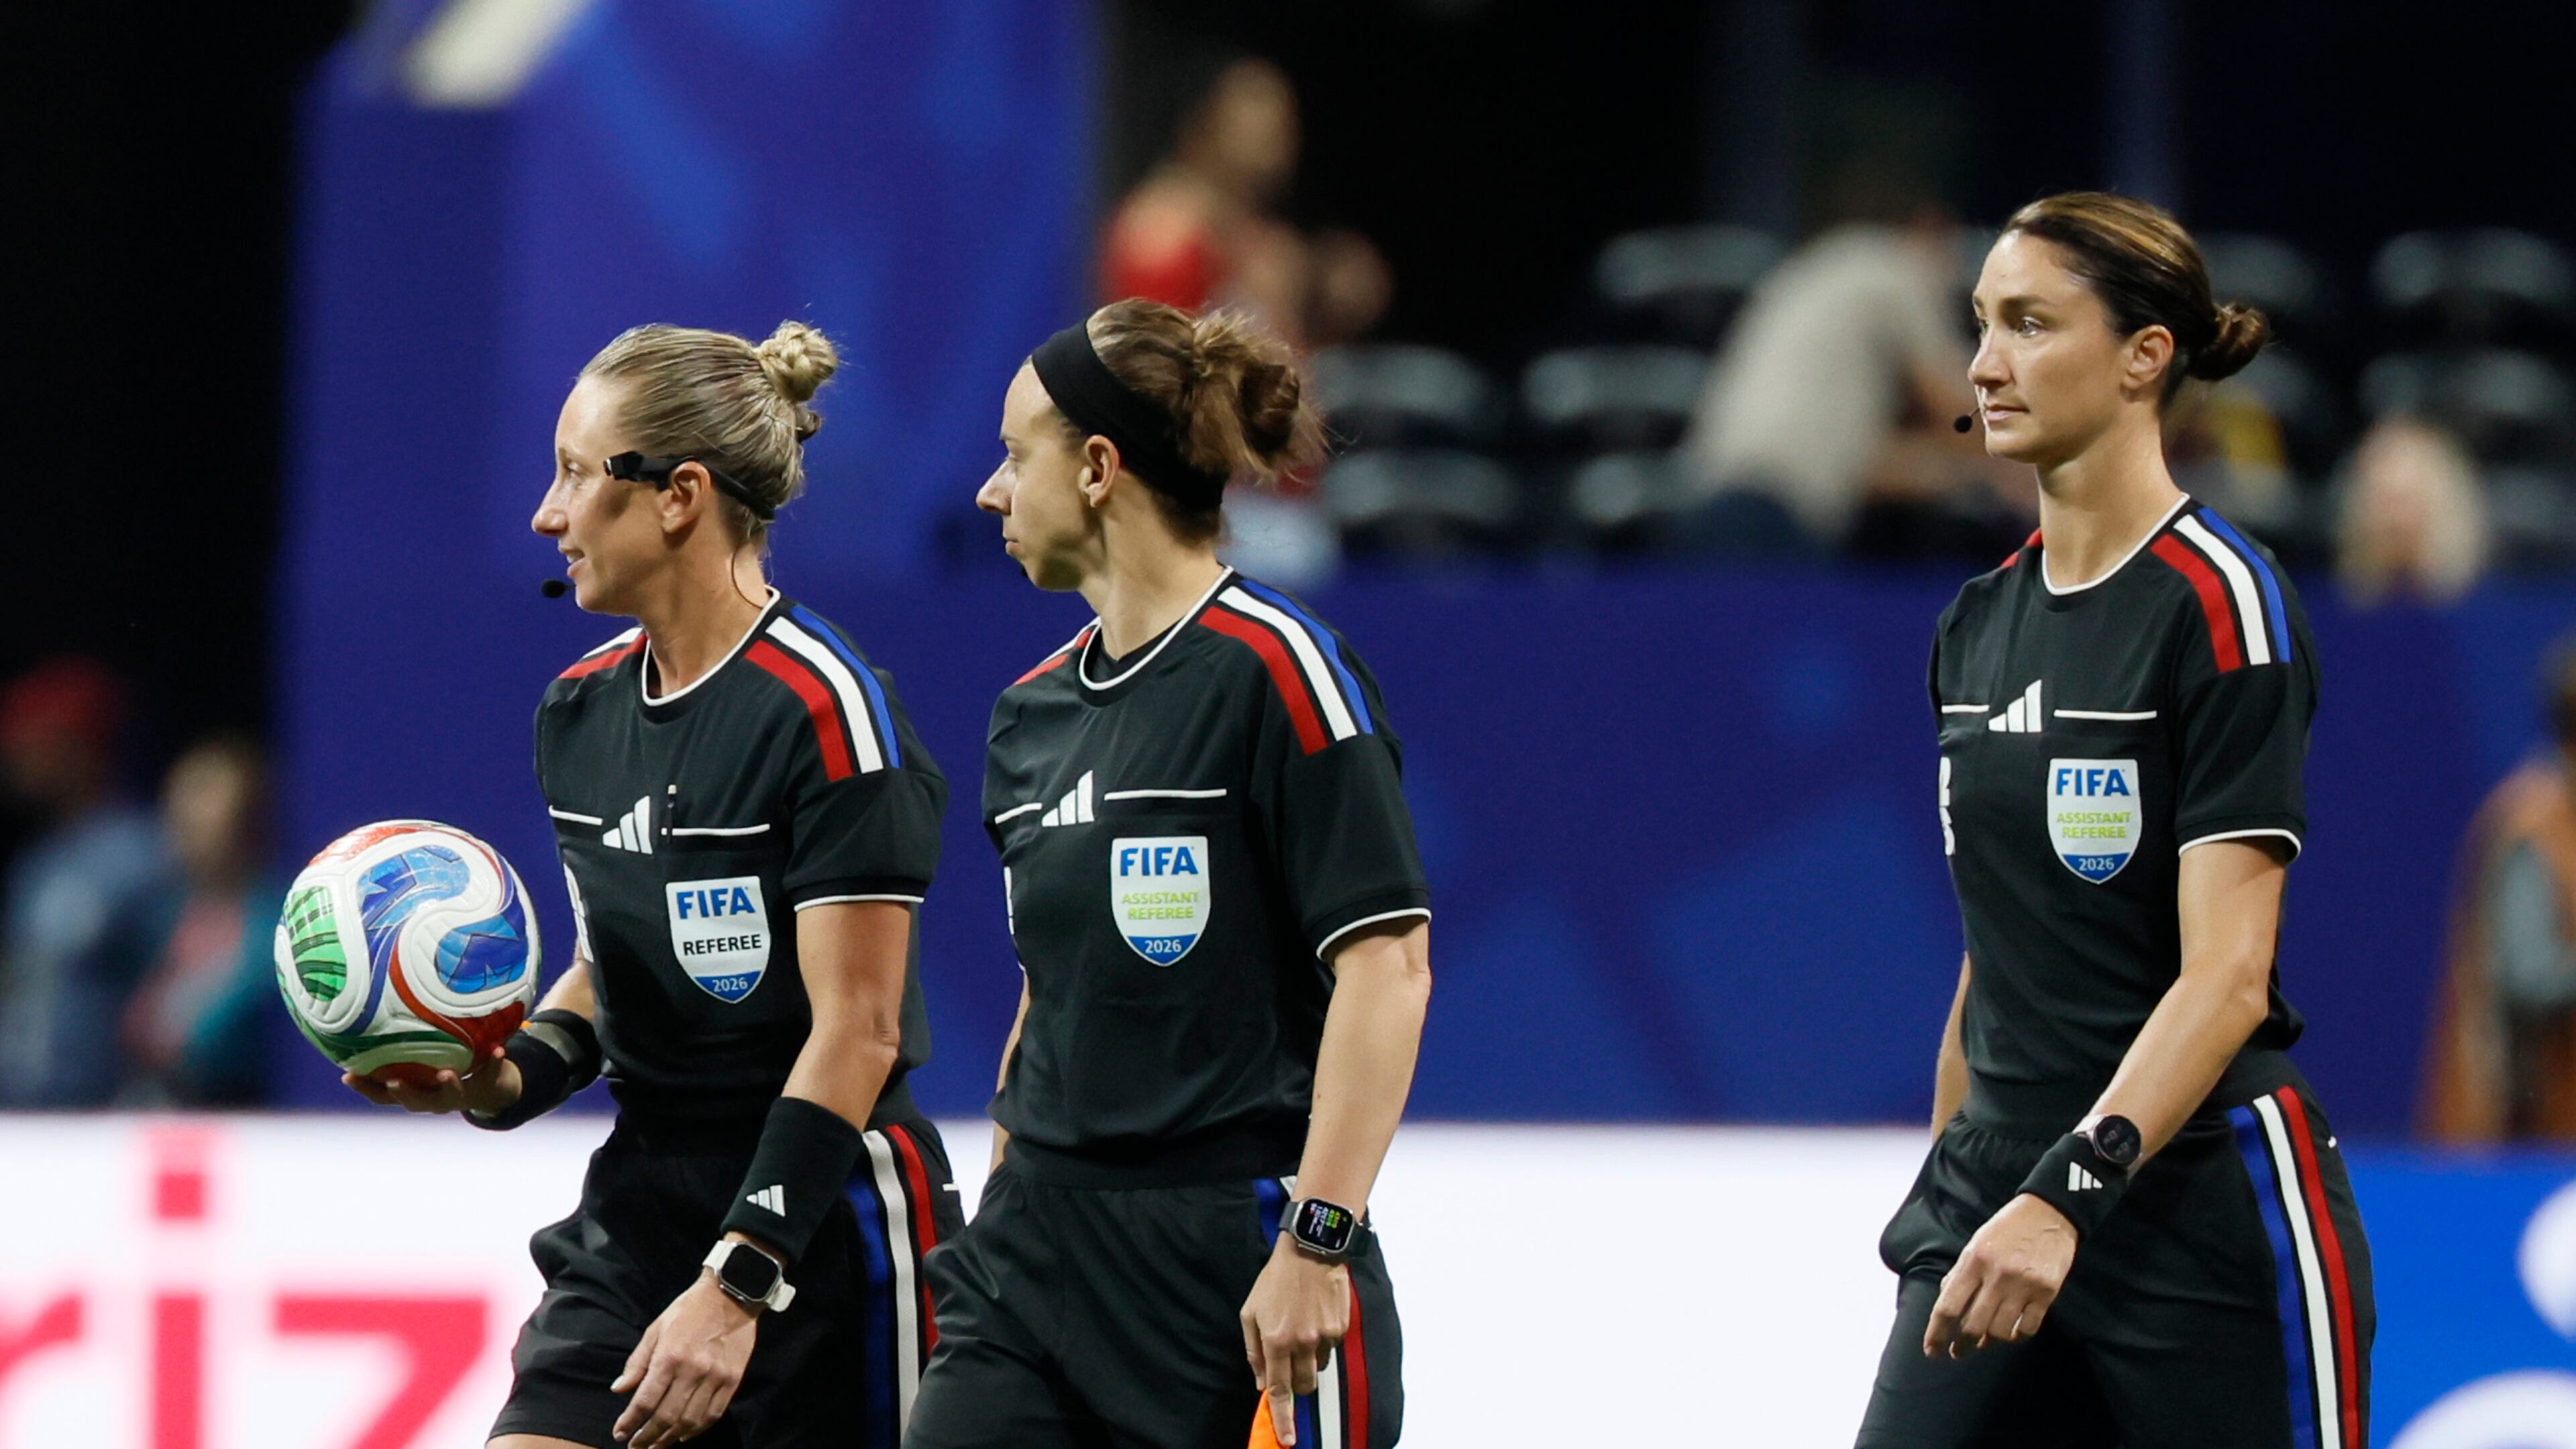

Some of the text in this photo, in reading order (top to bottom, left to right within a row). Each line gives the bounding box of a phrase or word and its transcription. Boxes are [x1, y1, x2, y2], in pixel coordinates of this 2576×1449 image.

[2056, 768, 2131, 797] FIFA
[2057, 811, 2132, 824] ASSISTANT
[2062, 826, 2127, 839] REFEREE
[1120, 846, 1199, 877] FIFA
[2078, 857, 2114, 871] 2026
[676, 886, 756, 920] FIFA
[1122, 891, 1199, 904] ASSISTANT
[1128, 906, 1194, 920] REFEREE
[683, 934, 762, 956] REFEREE
[1144, 938, 1181, 954] 2026
[712, 977, 748, 993] 2026
